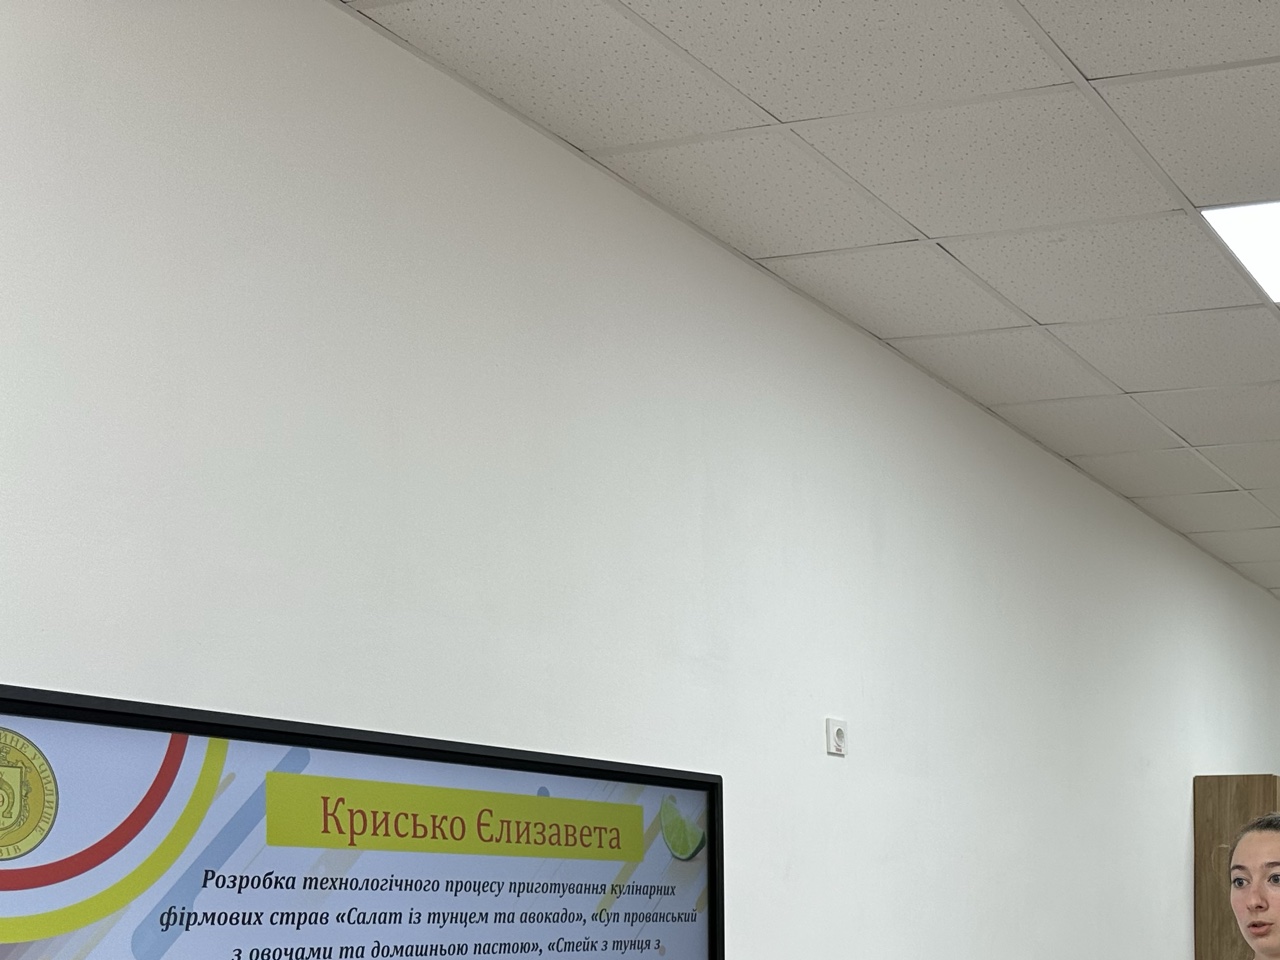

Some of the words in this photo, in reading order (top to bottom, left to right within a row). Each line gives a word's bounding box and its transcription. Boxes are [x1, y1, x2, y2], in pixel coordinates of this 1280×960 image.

[320, 796, 467, 847] Крисько
[476, 808, 622, 850] Єлизавета
[202, 869, 296, 894] Розробка
[302, 874, 440, 893] технологічного
[445, 880, 505, 898] процесу
[508, 881, 607, 898] приготування
[610, 880, 676, 899] кулінарних
[159, 906, 264, 932] фірмових
[269, 910, 330, 930] страв
[335, 907, 402, 926] «Салат
[408, 907, 422, 925] із
[427, 911, 489, 929] тунцем
[494, 910, 516, 925] та
[519, 908, 588, 927] авокадо»,
[591, 908, 621, 927] «Суп
[623, 907, 698, 928] прованський
[338, 943, 366, 960] та
[371, 940, 468, 959] домашньою
[473, 940, 544, 957] пастою»,
[547, 937, 599, 955] «Стейк
[601, 938, 608, 952] з
[612, 938, 652, 955] тунця
[654, 937, 661, 951] з
